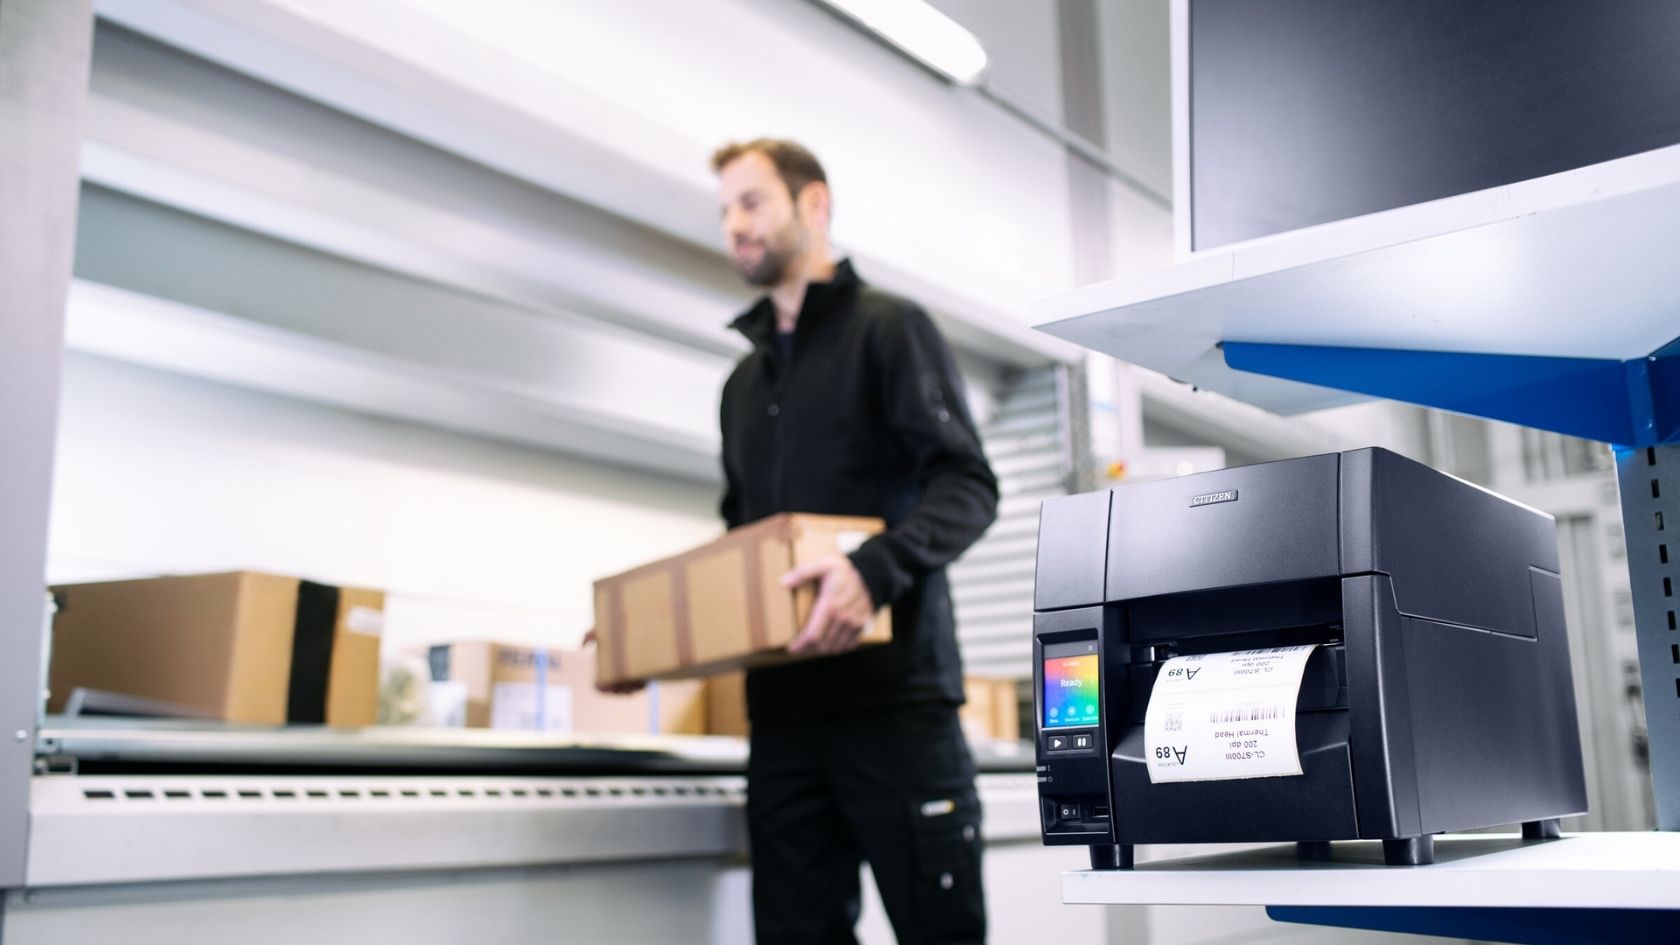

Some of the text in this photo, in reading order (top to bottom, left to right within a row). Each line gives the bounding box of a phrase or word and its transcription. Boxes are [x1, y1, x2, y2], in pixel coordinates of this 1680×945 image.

[1193, 491, 1232, 505] CITIZEN
[1168, 667, 1202, 680] A 89
[1060, 678, 1082, 688] Ready
[1214, 729, 1269, 739] Thermal Head
[1229, 740, 1258, 749] 200 dpi
[1155, 745, 1188, 765] A 89
